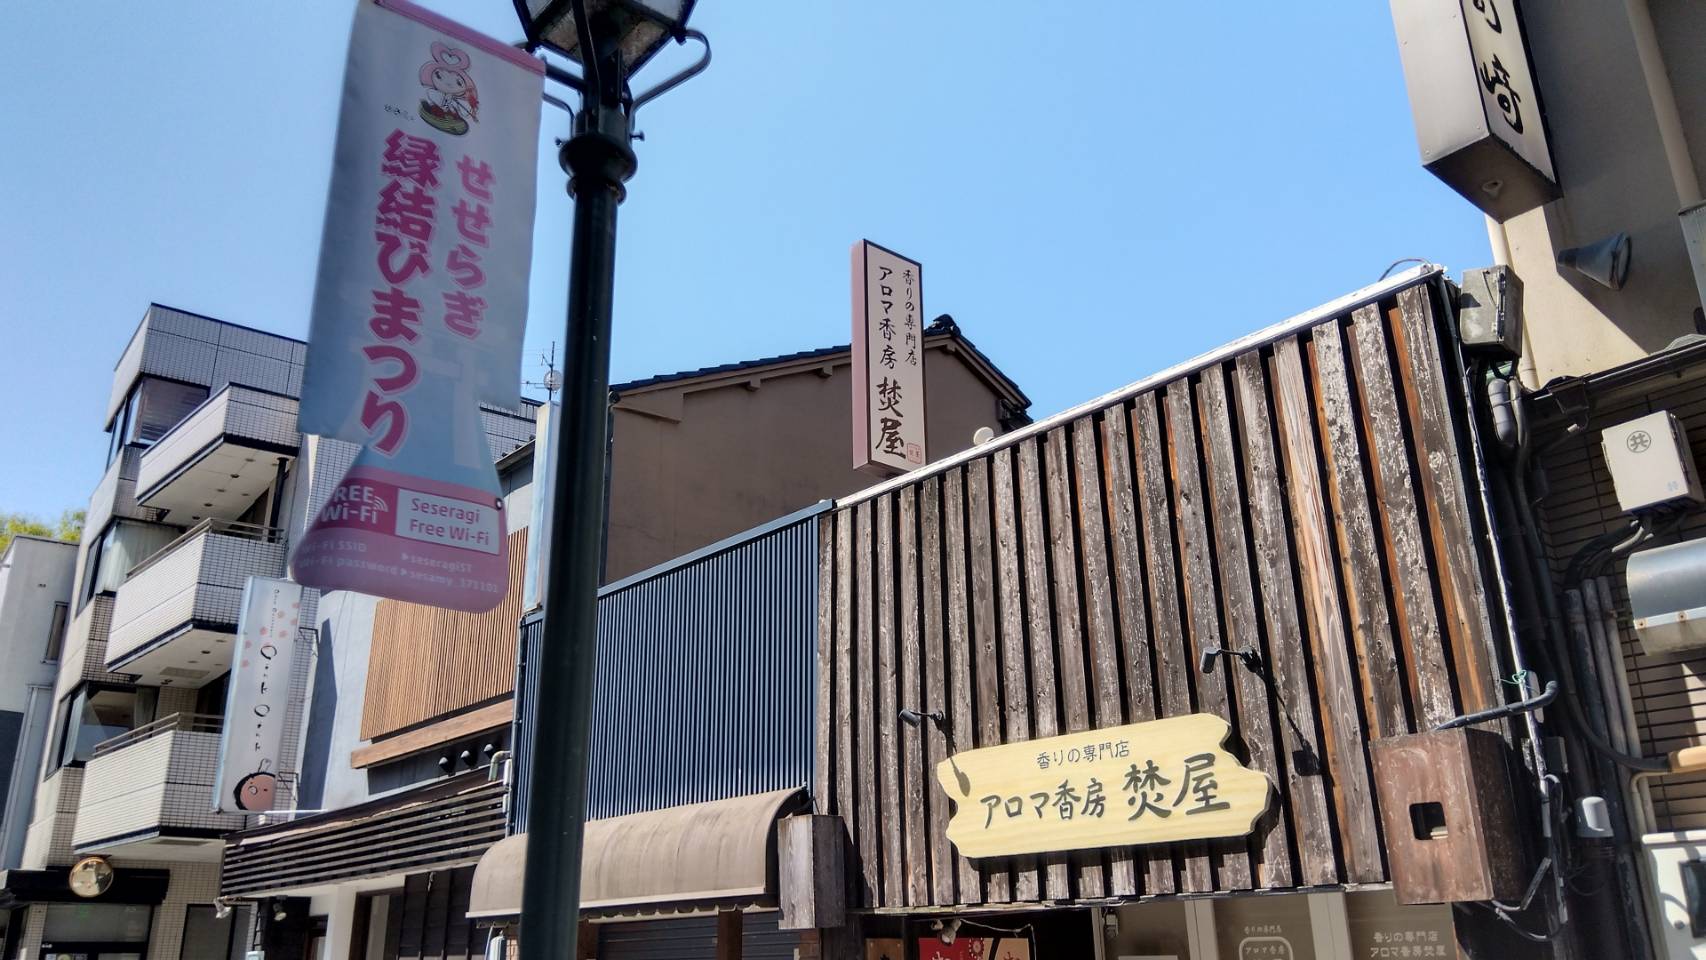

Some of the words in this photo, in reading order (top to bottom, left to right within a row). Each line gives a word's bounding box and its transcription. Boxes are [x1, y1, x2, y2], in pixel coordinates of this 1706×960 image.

[440, 153, 496, 341] せせらぎ
[361, 128, 441, 458] 縁結びまつり
[878, 265, 898, 370] アロマ香房
[902, 269, 917, 367] 香りの専門店
[875, 376, 907, 460] 焚屋
[320, 502, 378, 524] Wi-Fi
[334, 484, 375, 504] REE
[409, 518, 445, 537] Free
[449, 525, 490, 546] Wi-Fi
[410, 498, 481, 525] Seseragi
[980, 777, 1106, 830] アロマ香房
[1122, 752, 1231, 822] 焚屋
[1036, 740, 1130, 769] 香りの専門店
